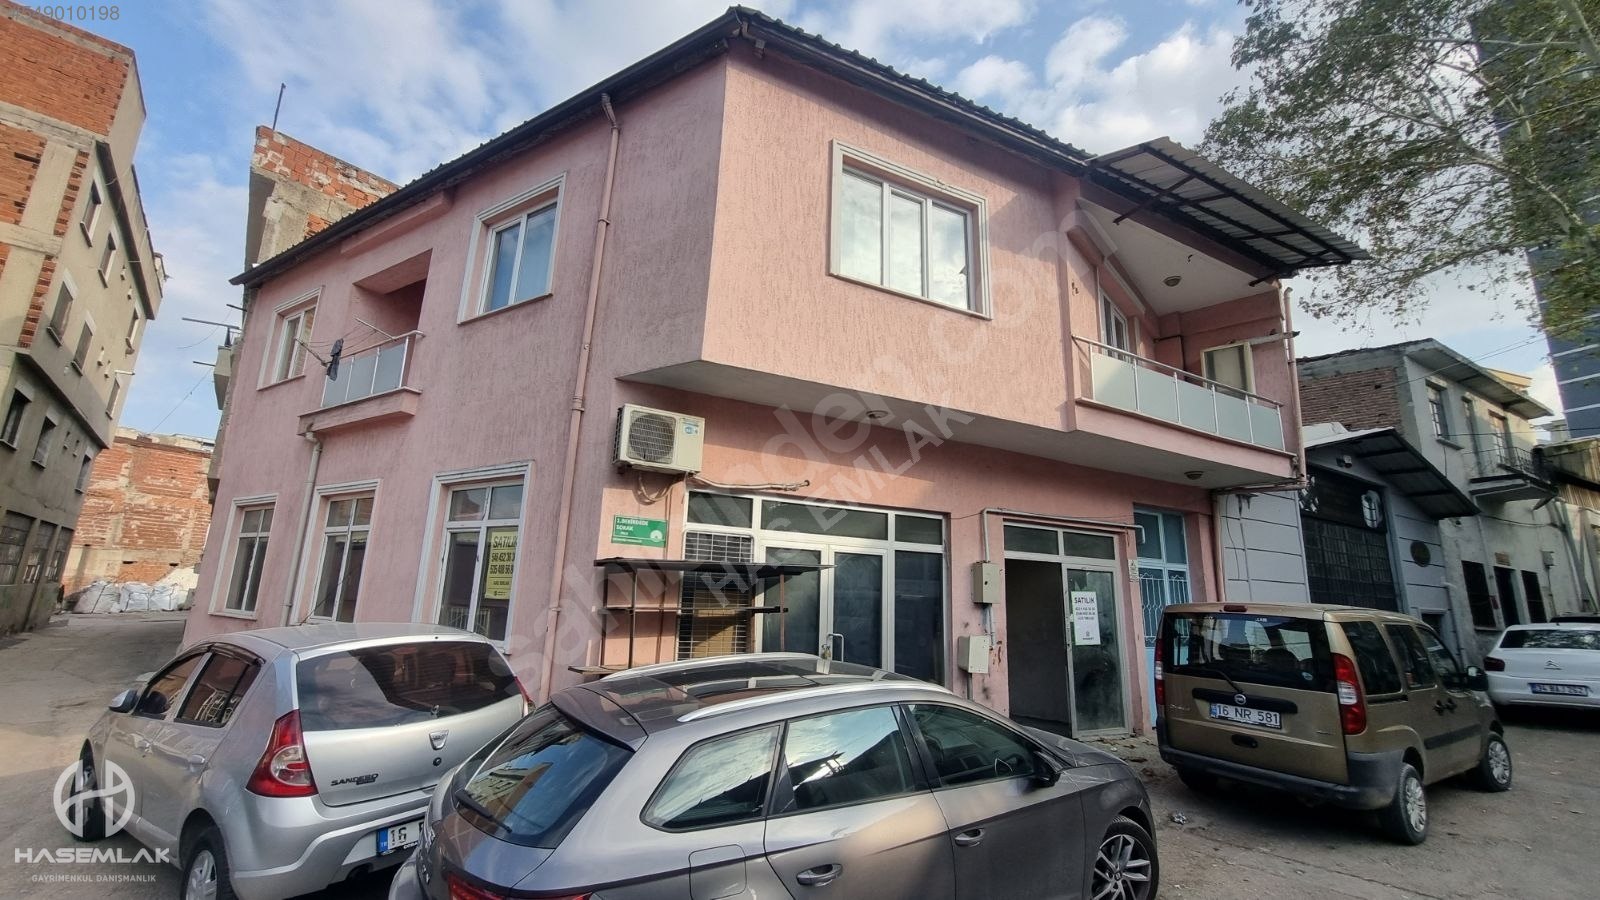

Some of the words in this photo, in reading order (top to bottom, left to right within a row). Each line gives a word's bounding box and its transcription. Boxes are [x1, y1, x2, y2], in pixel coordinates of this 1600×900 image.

[1217, 704, 1229, 716] 16
[1234, 707, 1252, 720] NR
[1257, 711, 1278, 725] 581
[330, 773, 379, 787] SANDERO
